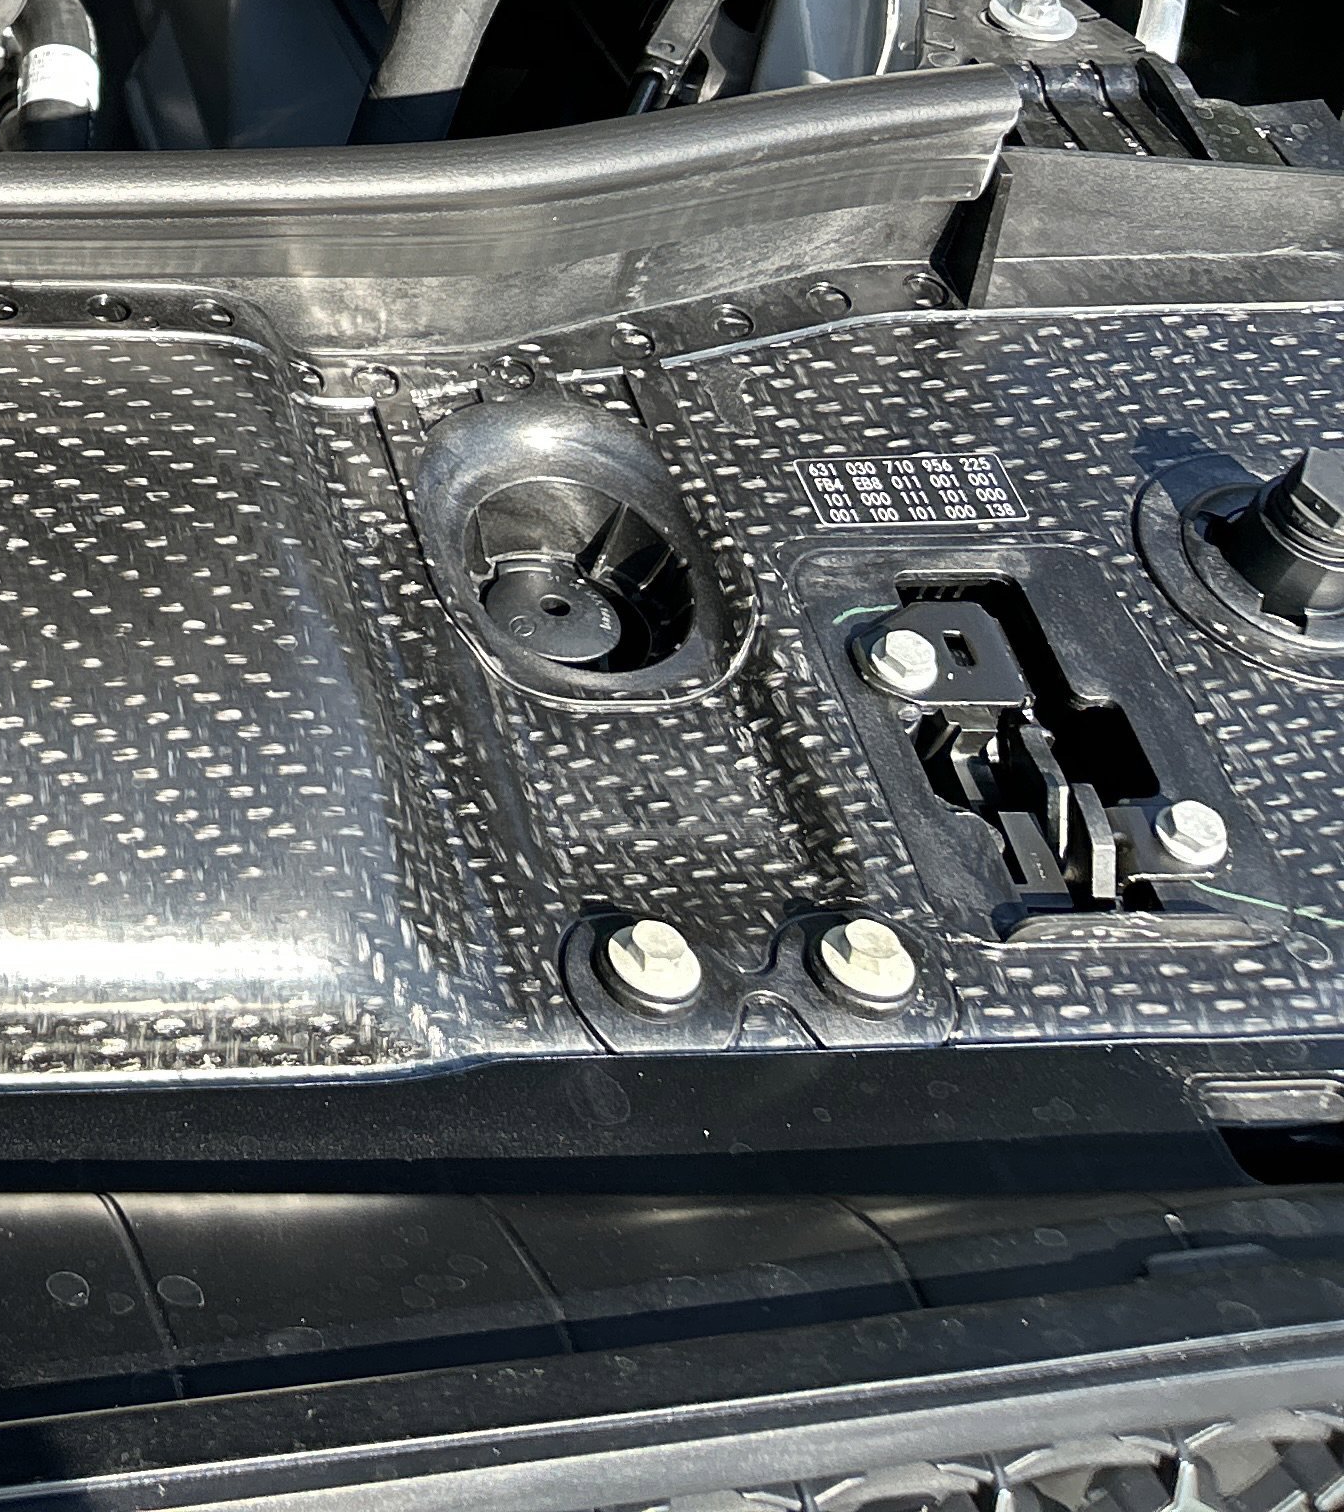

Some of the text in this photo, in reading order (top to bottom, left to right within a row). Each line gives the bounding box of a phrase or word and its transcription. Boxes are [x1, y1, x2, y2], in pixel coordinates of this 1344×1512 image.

[809, 457, 990, 477] 631 030 710 956 225
[814, 473, 998, 492] FB4 EB8 011 001 001
[824, 488, 1006, 507] 101 000 111 101 000
[830, 503, 1015, 523] 001 100 101 000 138
